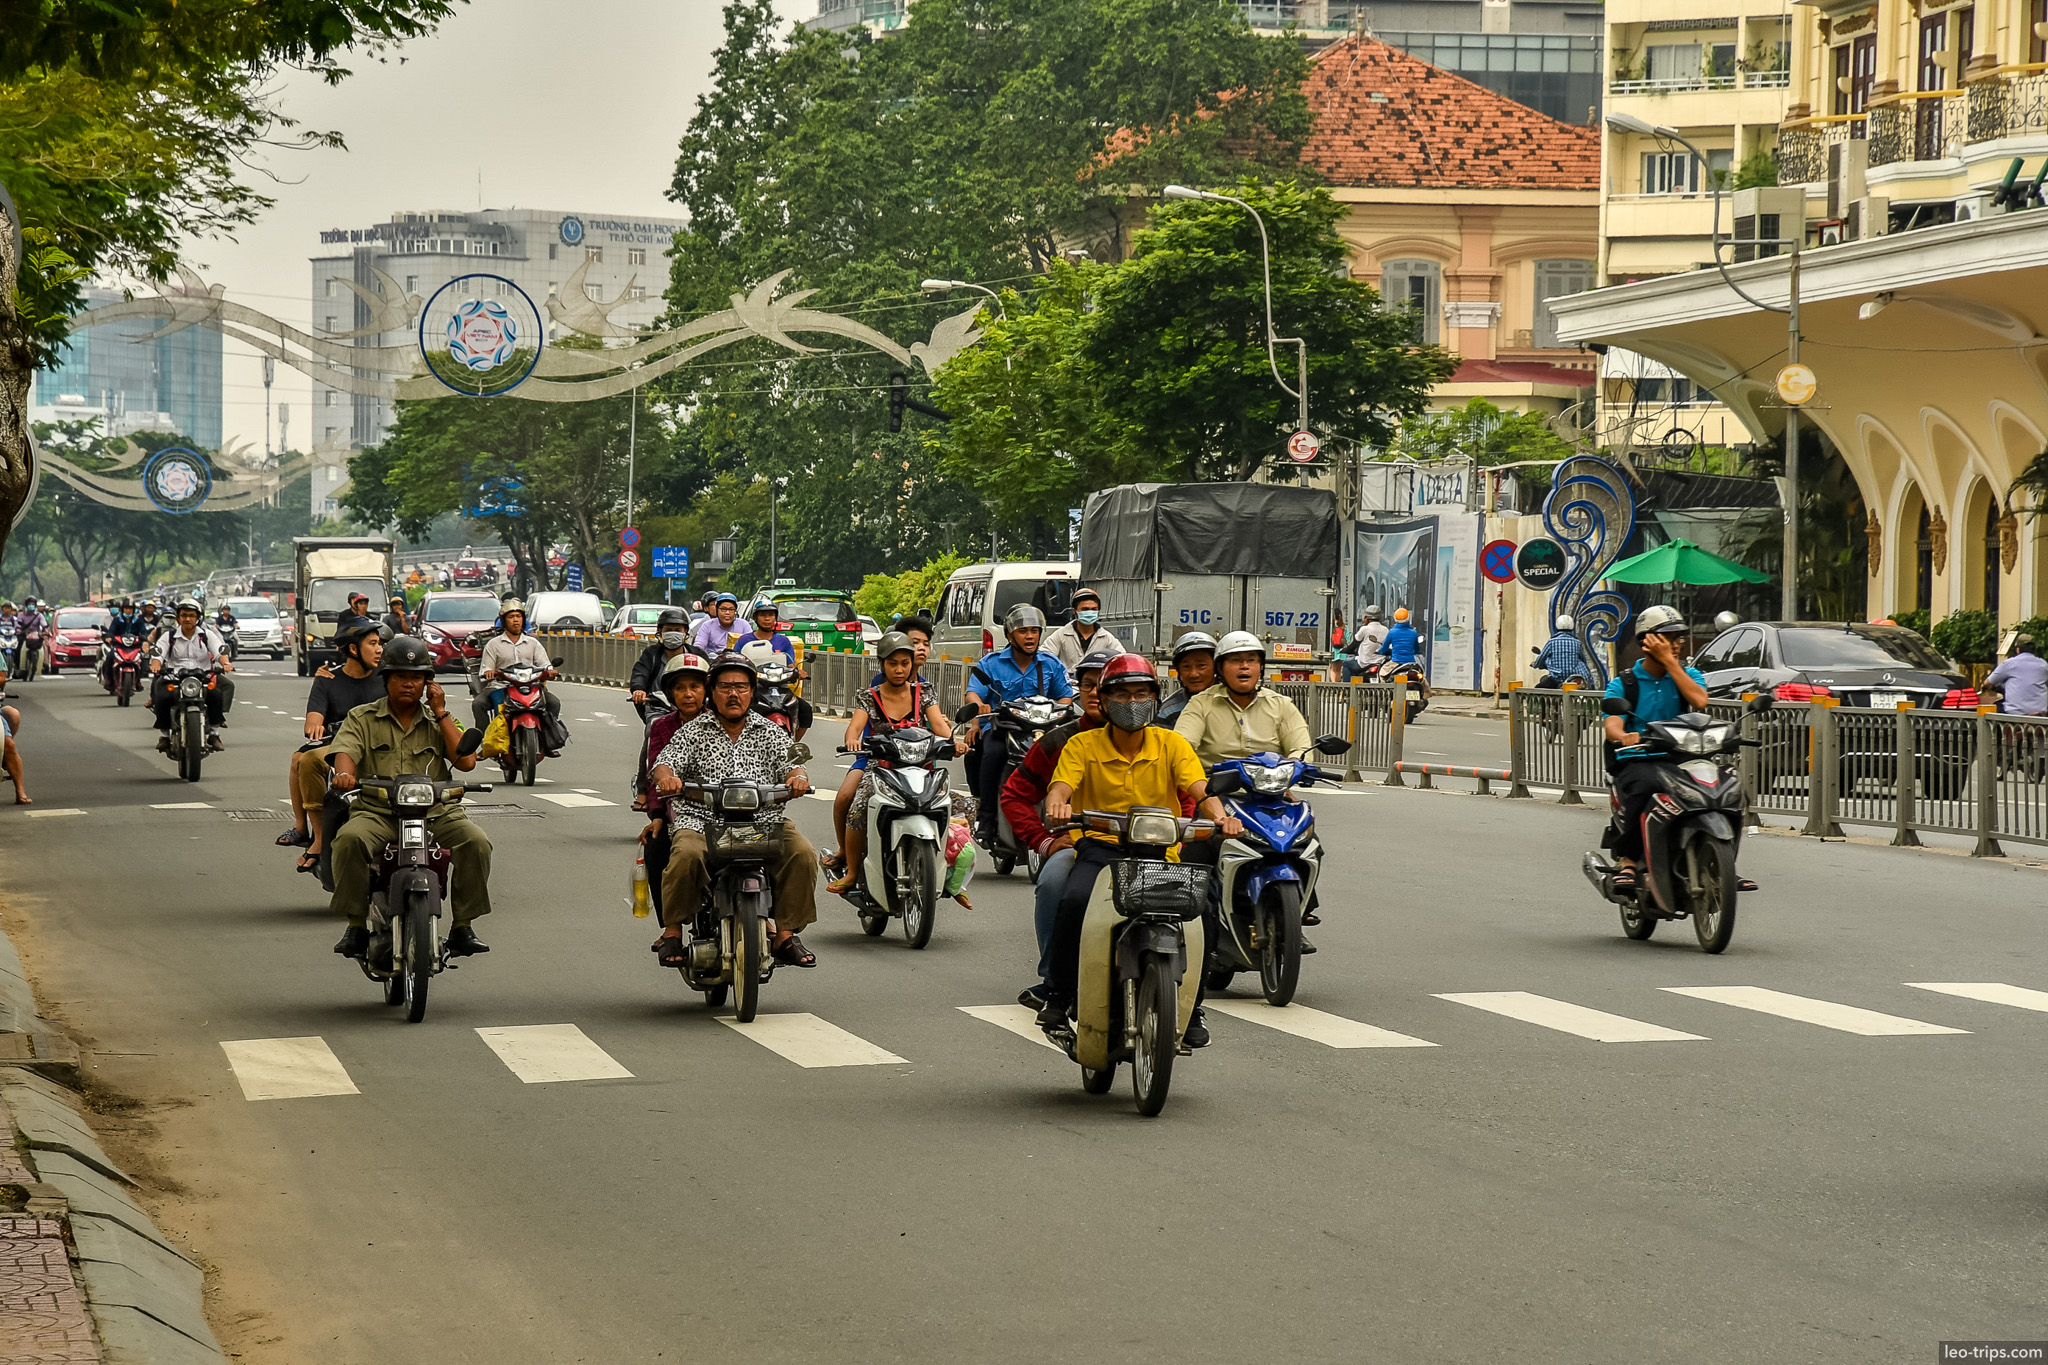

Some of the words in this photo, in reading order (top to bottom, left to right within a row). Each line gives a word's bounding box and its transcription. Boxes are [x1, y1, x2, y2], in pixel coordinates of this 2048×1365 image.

[654, 236, 675, 245] MIN
[1523, 567, 1560, 577] SPECIAL
[1180, 609, 1211, 624] 51C
[1265, 611, 1319, 627] 567.22
